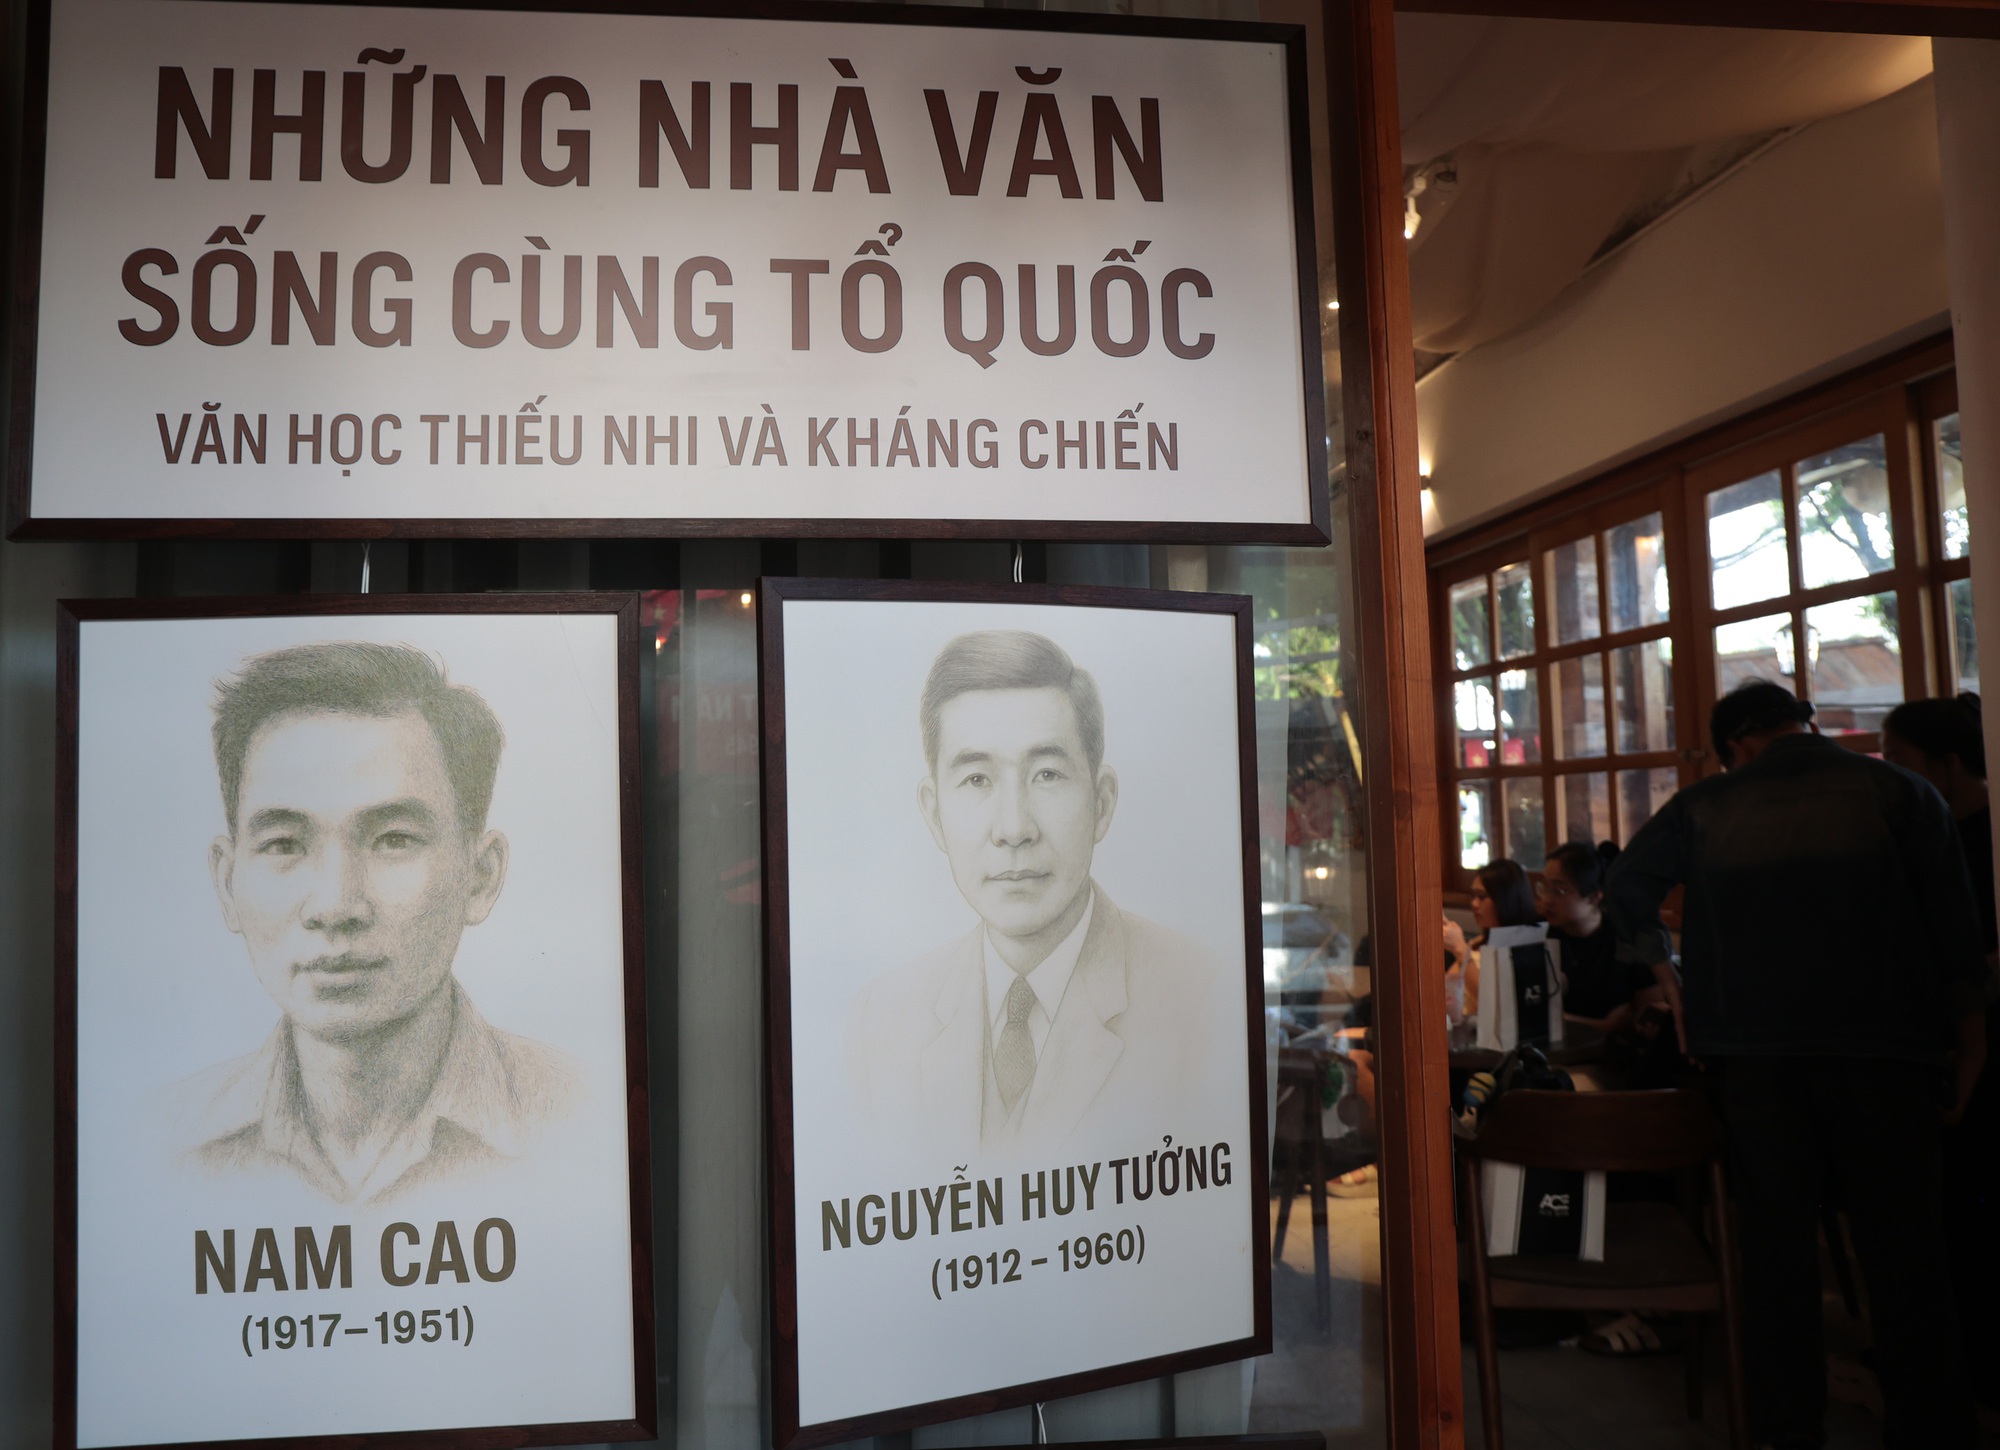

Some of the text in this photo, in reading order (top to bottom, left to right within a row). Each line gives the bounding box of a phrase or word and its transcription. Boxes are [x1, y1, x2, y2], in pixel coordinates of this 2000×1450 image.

[155, 48, 1164, 203] NHỮNG NHÀ VĂN
[118, 214, 1216, 370] SỐNG CÙNG TỔ QUỐC
[156, 395, 1179, 477] VĂN HỌC THIẾU NHI VÀ KHÁNG CHIẾN
[821, 1135, 1232, 1252] NGUYỄN HUY TƯỞNG
[195, 1217, 517, 1295] NAM CAO
[931, 1248, 1022, 1301] (1912
[1057, 1225, 1146, 1273] 1960)
[242, 1305, 474, 1358] (1917–1951)
